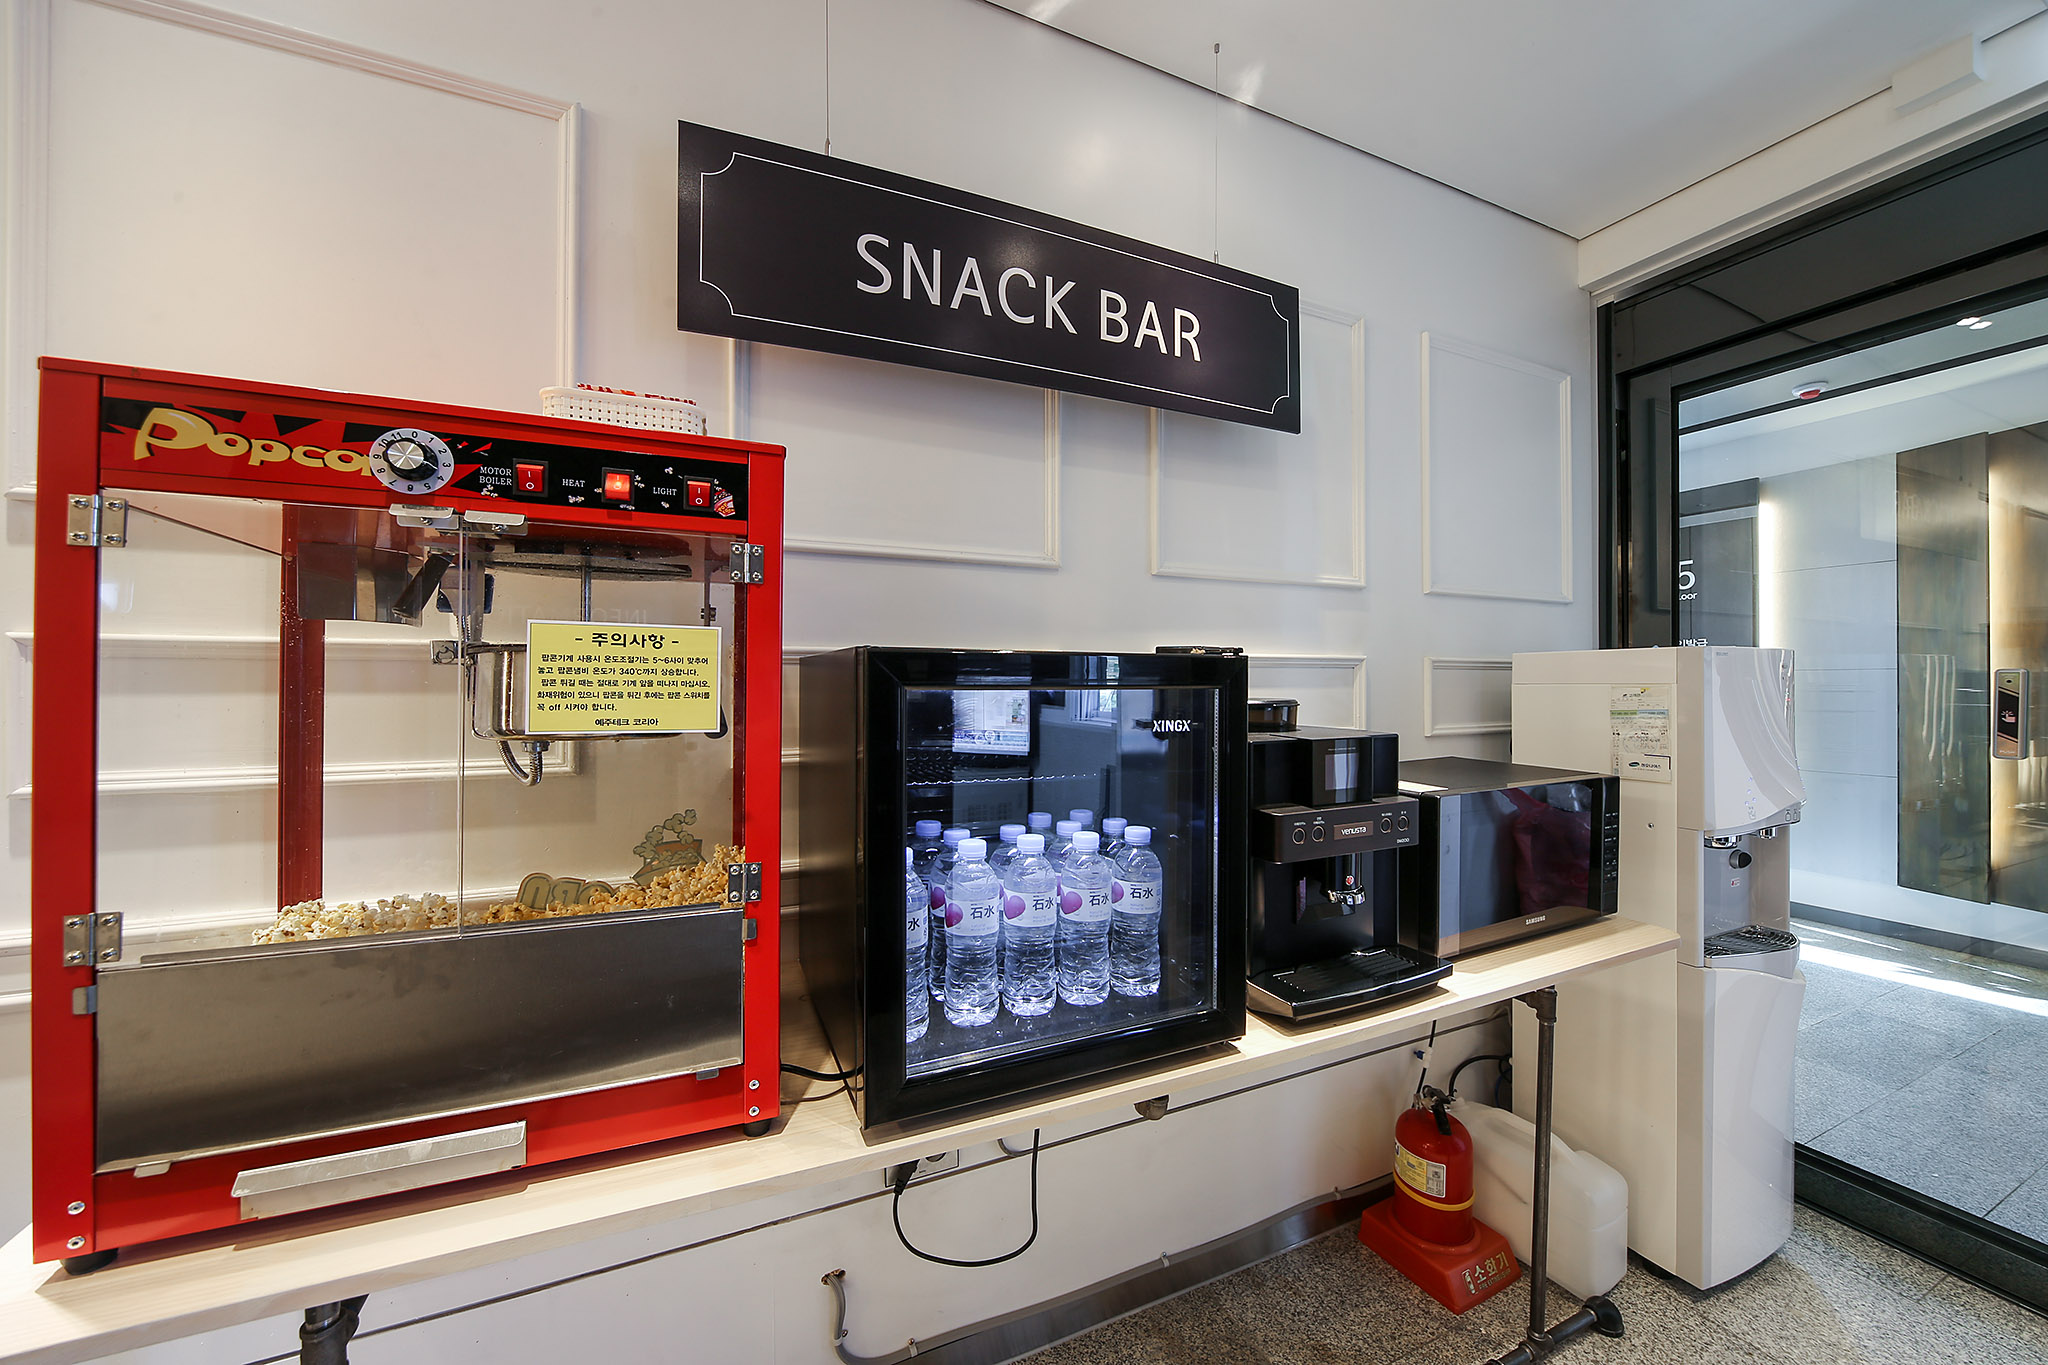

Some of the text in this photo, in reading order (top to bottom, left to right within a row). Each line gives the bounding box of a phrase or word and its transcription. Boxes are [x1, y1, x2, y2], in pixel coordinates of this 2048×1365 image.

[855, 232, 1202, 362] SNACK BAR
[391, 432, 402, 440] 11
[411, 430, 418, 439] 0
[378, 438, 389, 448] 10
[480, 466, 512, 477] MOTOR
[423, 482, 431, 490] 5
[479, 475, 513, 486] BOILER
[562, 478, 586, 488] HEAT
[407, 484, 413, 492] 6
[653, 486, 677, 496] LIGHT
[591, 632, 666, 650] 주의사항
[541, 653, 709, 665] 팝콘기계 사용시 온도조절기는 5~6사이 맞추어
[537, 666, 554, 675] 놓고
[557, 666, 589, 675] 팝콘냄비
[592, 667, 616, 675] 온도가
[660, 668, 699, 677] 상승합니다.
[541, 679, 557, 687] 팝콘
[560, 679, 576, 687] 튀길
[578, 679, 594, 687] 때는
[596, 679, 619, 687] 절대로
[622, 679, 637, 687] 기계
[639, 679, 654, 688] 앞을
[680, 680, 710, 688] 마십시오.
[537, 690, 710, 700] 화재위험이 있으니 팝콘을 튀긴 후에는 팝콘 스위치를
[537, 703, 618, 712] 꼭 off 시켜야 합니다.
[632, 717, 659, 726] 코리아
[1152, 719, 1191, 732] XINGX
[1129, 887, 1154, 899] 石水
[1032, 896, 1054, 912] 石水
[1088, 892, 1110, 907] 石水
[970, 904, 995, 920] 石水
[1474, 1251, 1509, 1284] 소화기
